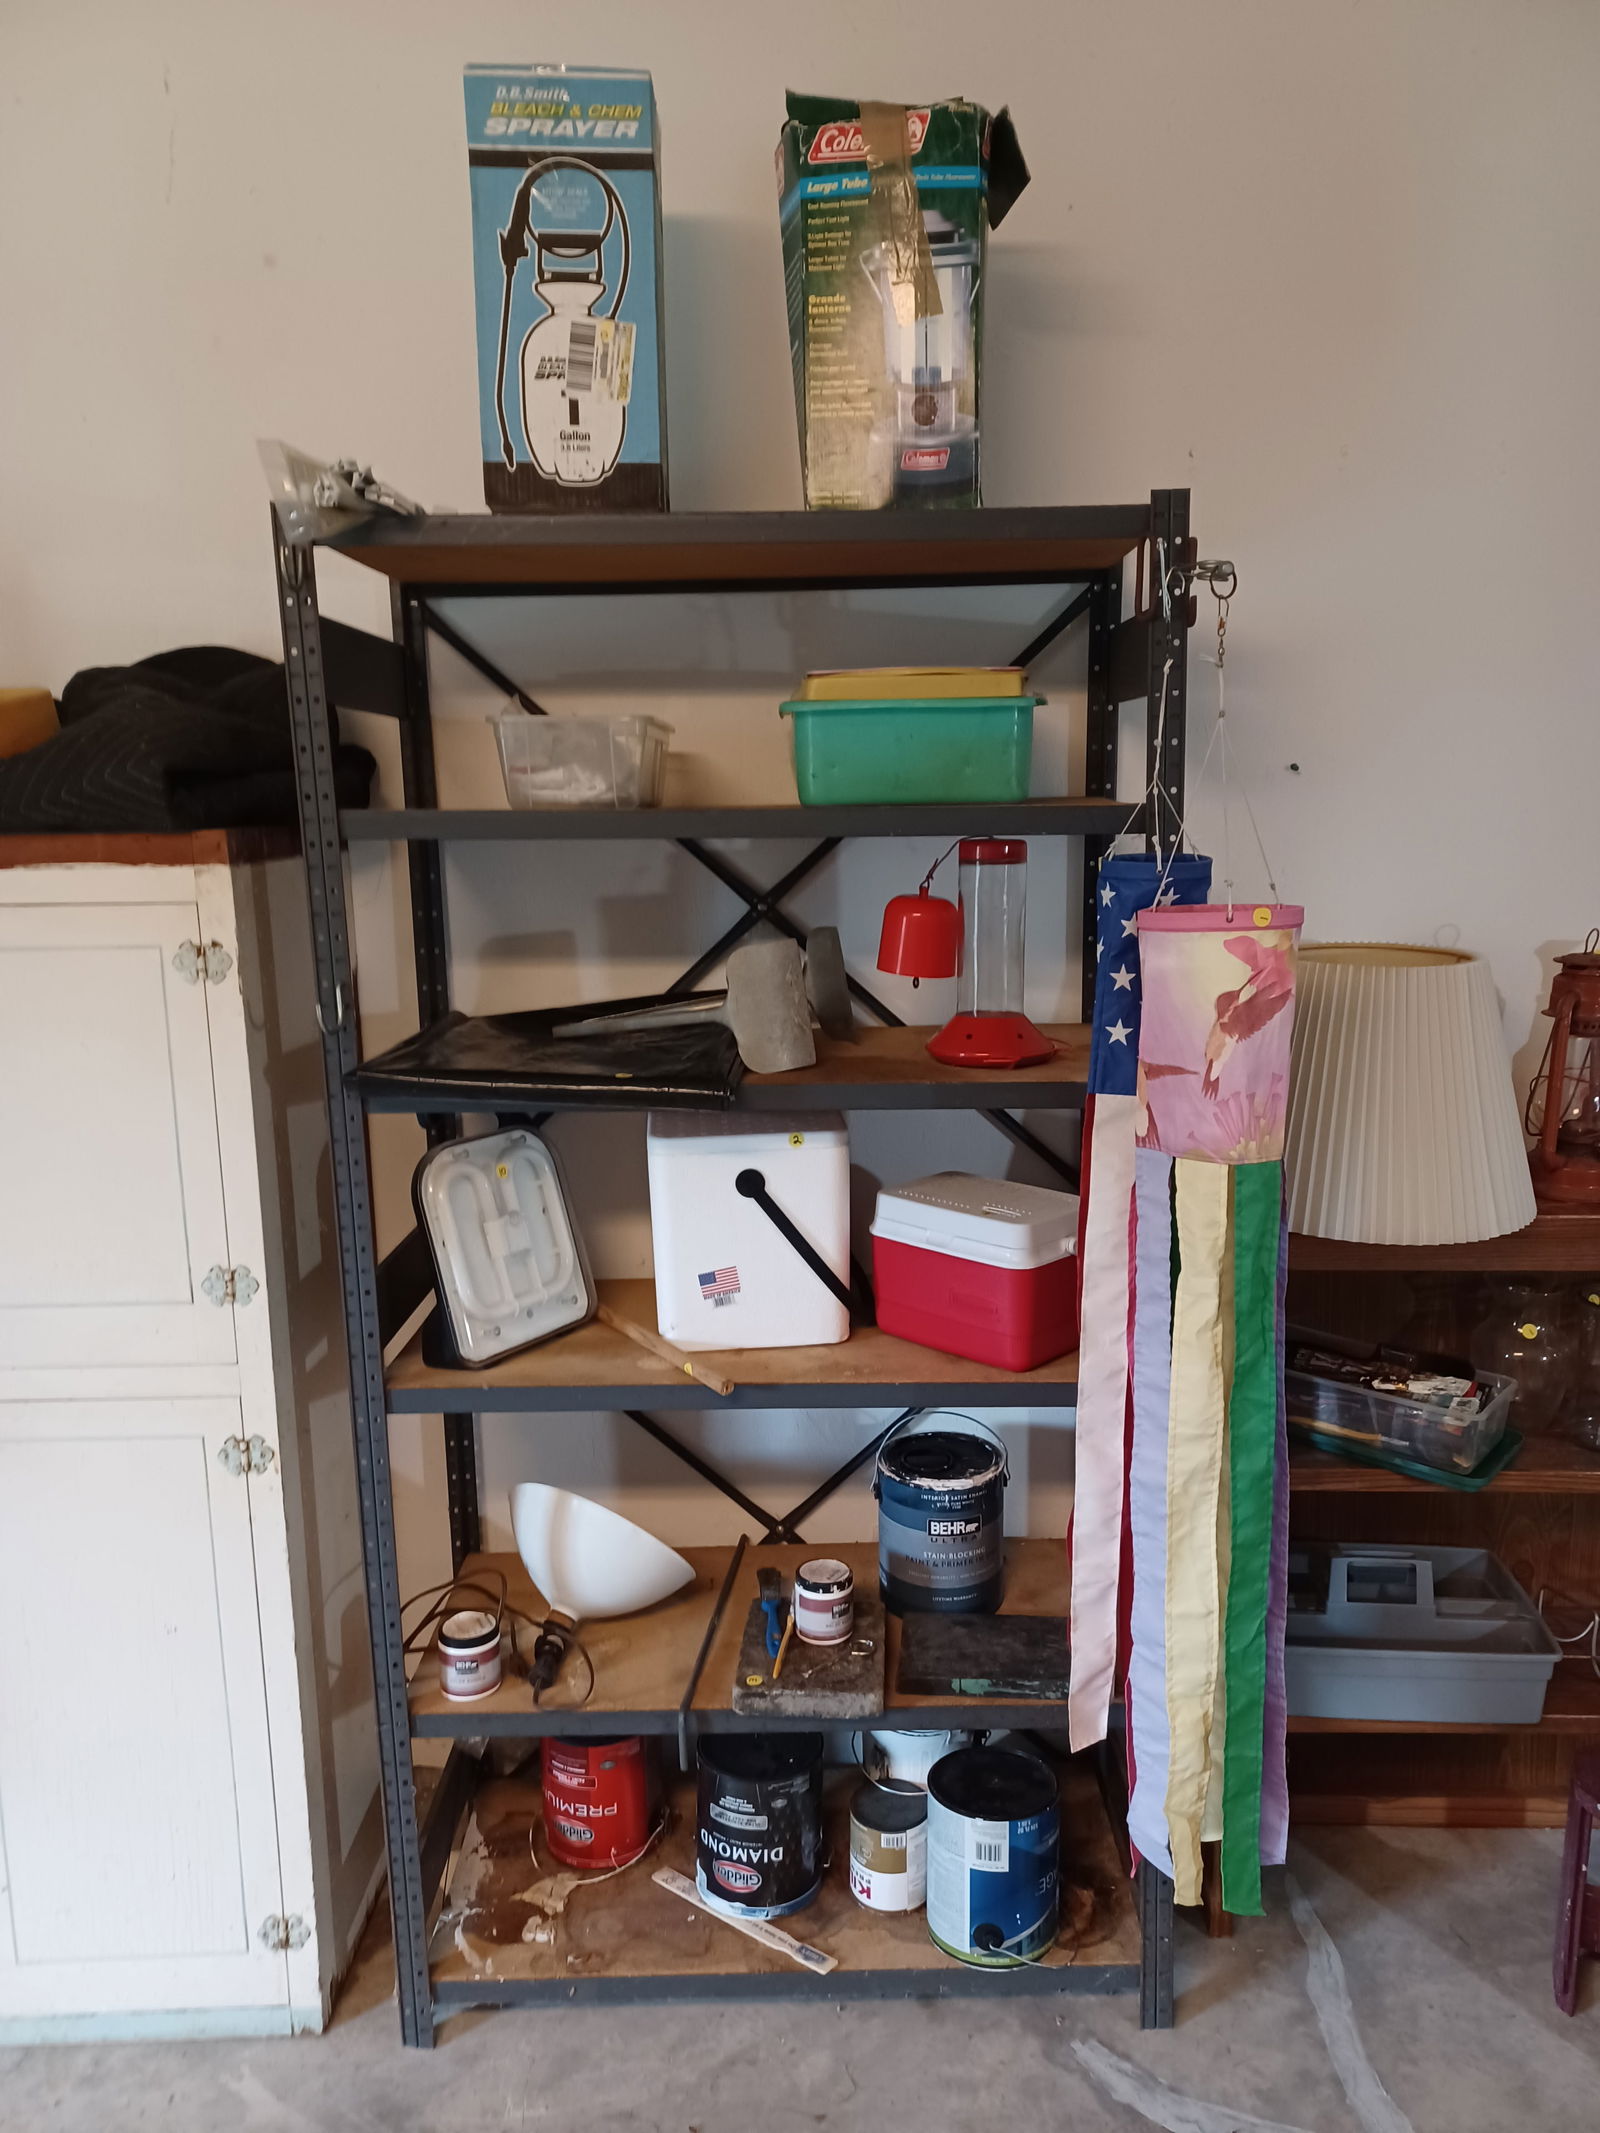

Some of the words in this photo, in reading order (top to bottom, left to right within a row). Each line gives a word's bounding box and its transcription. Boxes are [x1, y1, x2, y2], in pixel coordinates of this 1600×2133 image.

[490, 102, 565, 117] BLEACH
[569, 104, 581, 117] &
[588, 104, 643, 119] CHEM
[484, 117, 639, 138] SPRAYER
[820, 128, 865, 152] Cole
[807, 181, 839, 195] Large
[842, 176, 869, 190] Tube
[559, 430, 591, 441] Gallon
[930, 1521, 966, 1535] BEHR
[544, 1788, 618, 1818] PREMIU
[701, 1828, 784, 1864] DIAMOND
